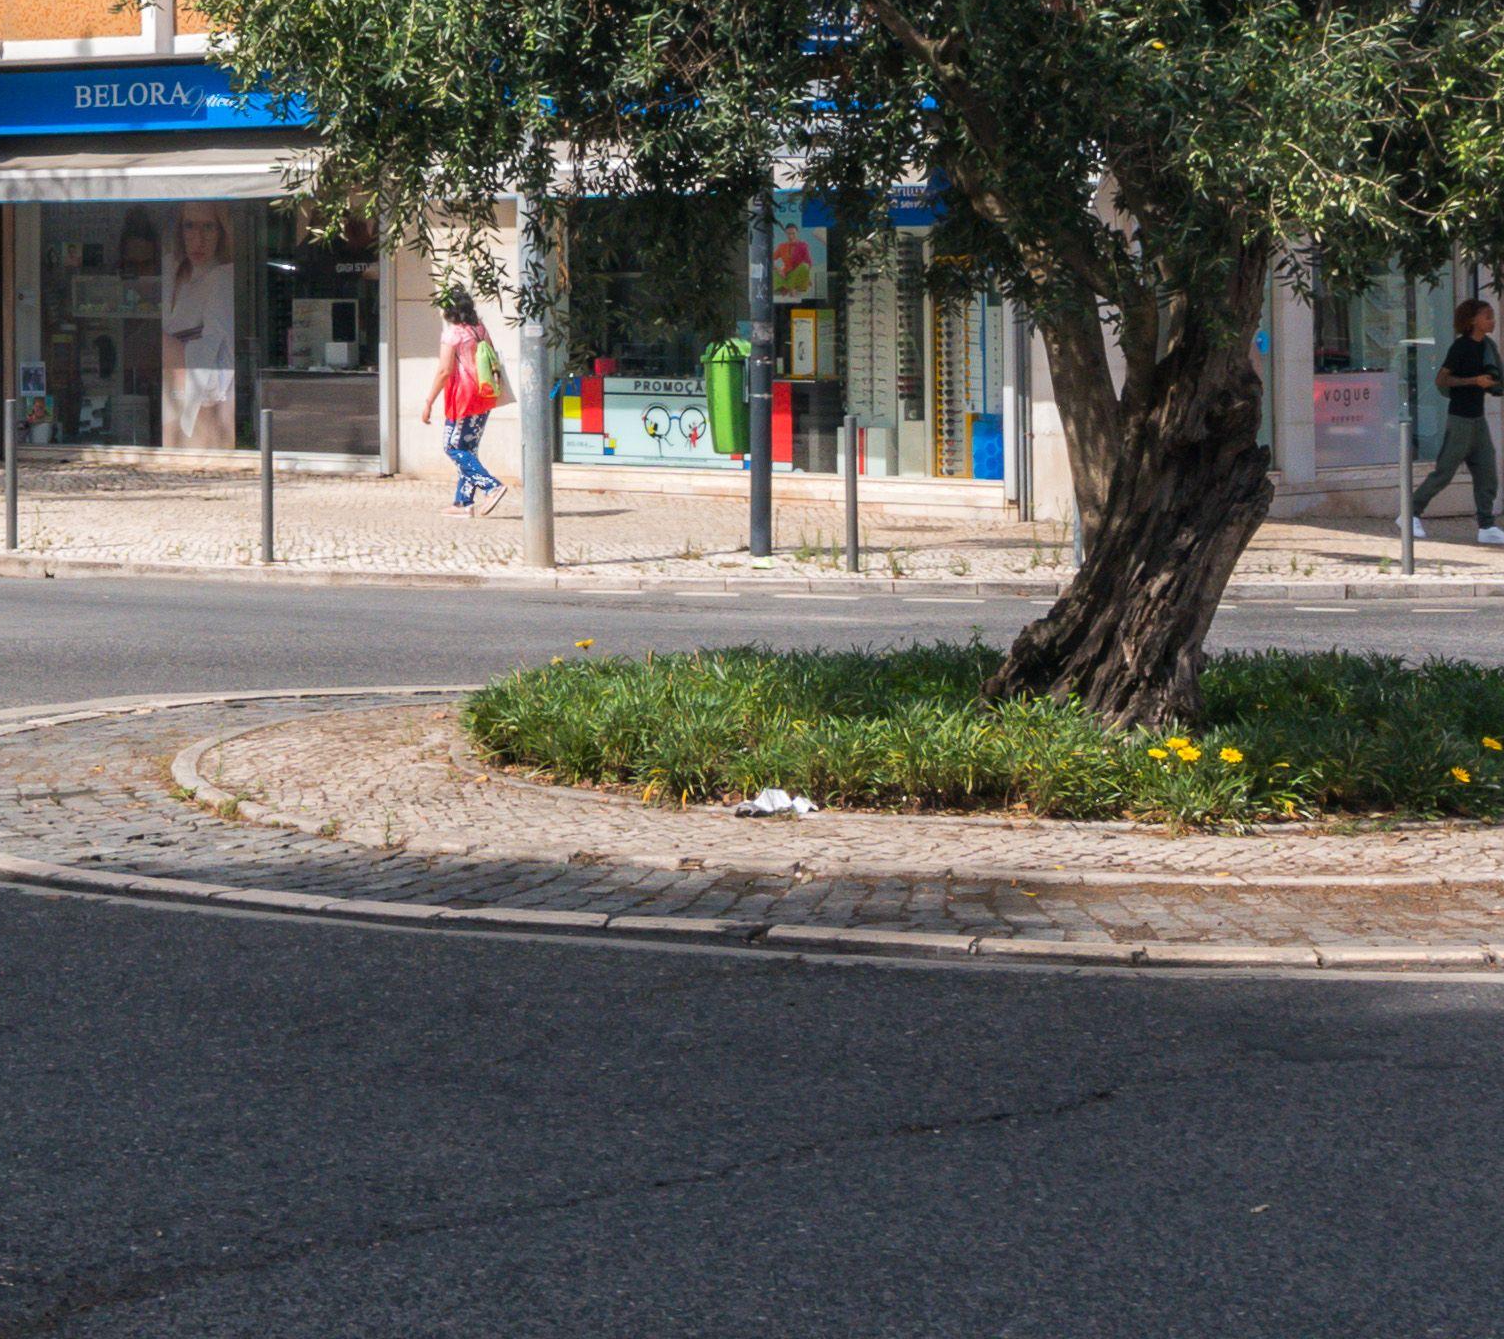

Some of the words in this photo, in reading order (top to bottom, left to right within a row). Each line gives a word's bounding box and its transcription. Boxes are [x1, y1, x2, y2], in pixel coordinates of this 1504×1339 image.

[74, 81, 191, 109] BELORA
[633, 379, 705, 396] PROMOÇÃ
[1323, 387, 1371, 407] vogue
